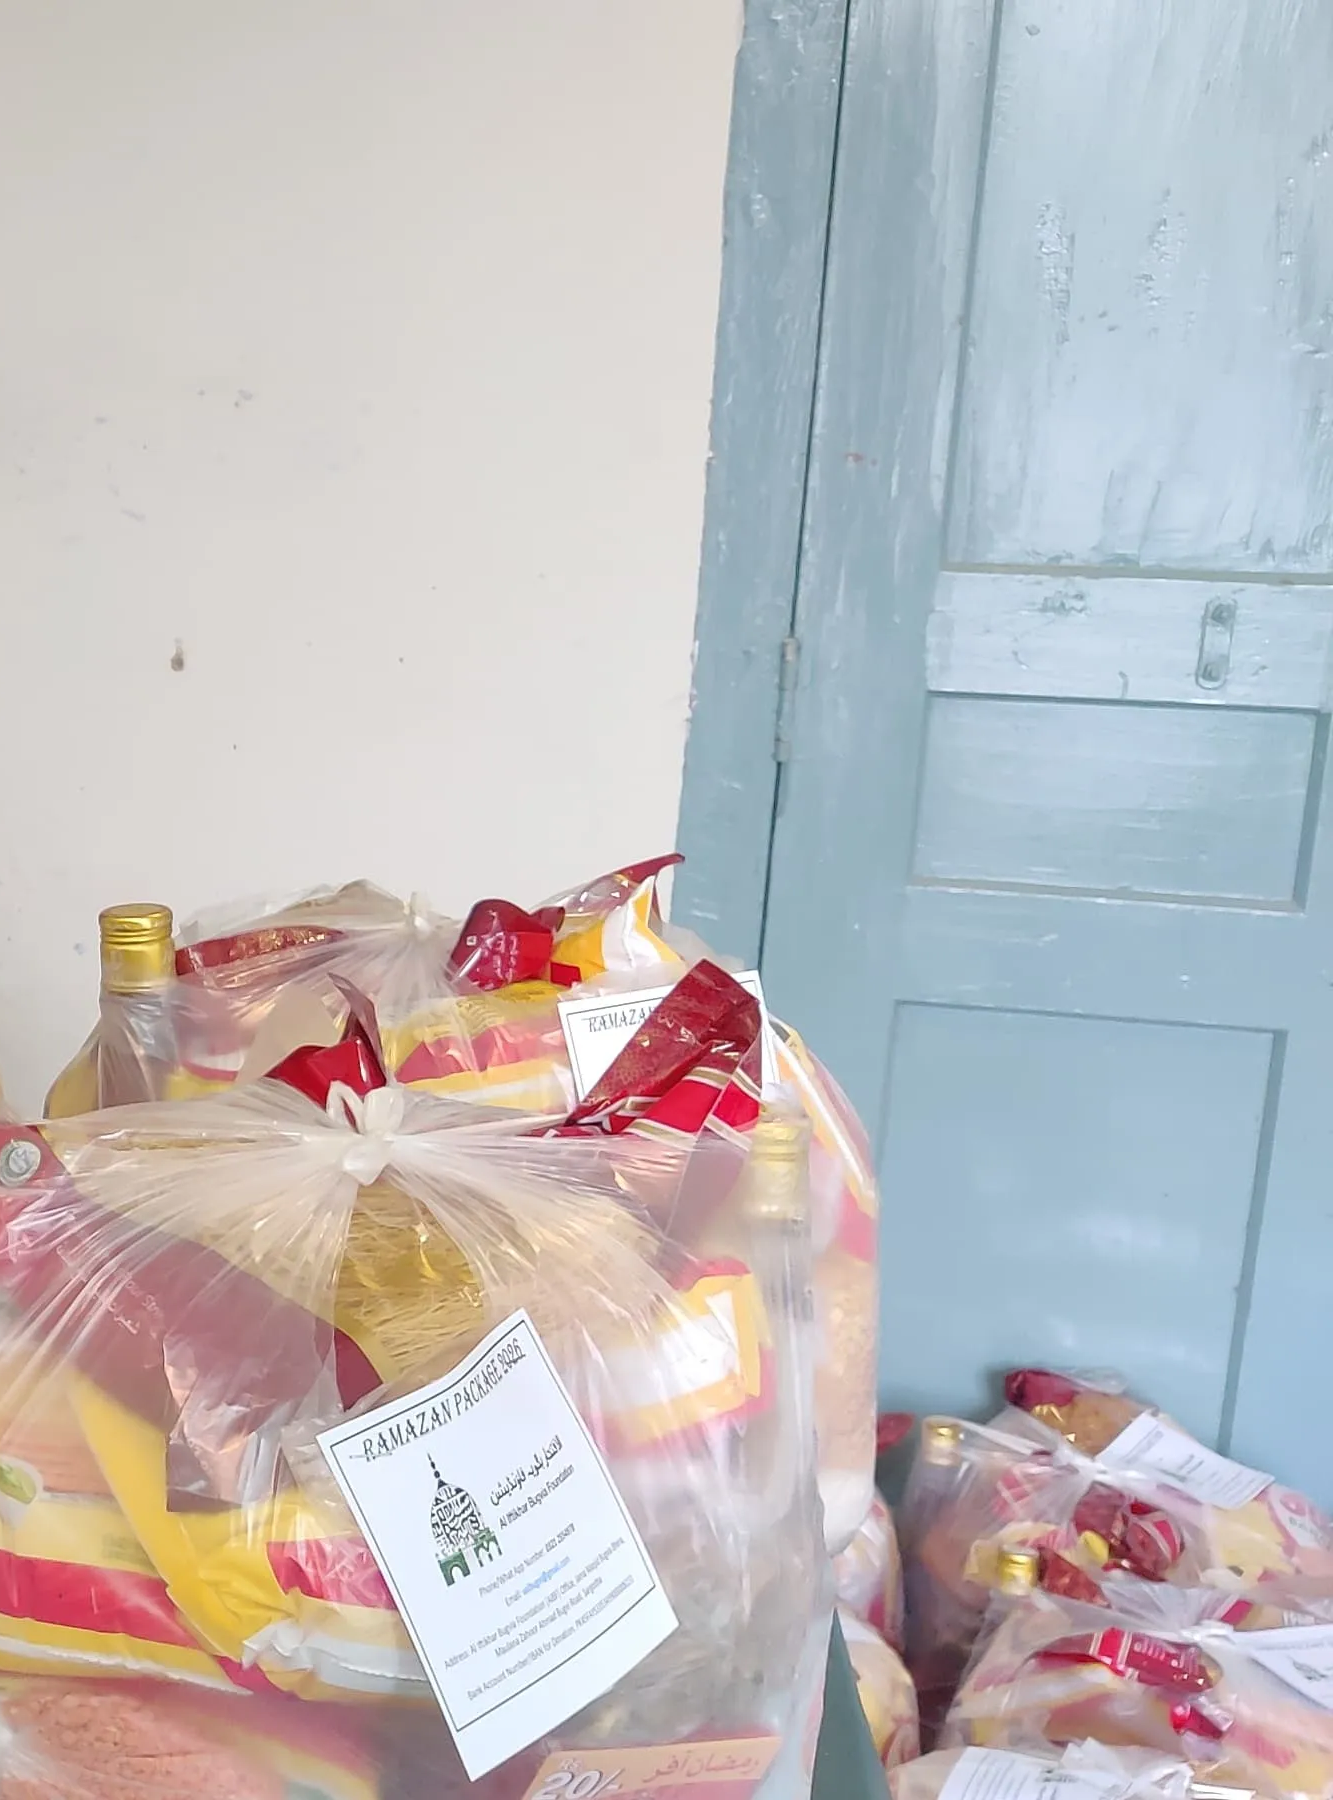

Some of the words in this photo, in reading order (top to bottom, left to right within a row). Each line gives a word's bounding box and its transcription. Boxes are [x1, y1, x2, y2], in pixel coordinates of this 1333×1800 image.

[363, 1398, 454, 1462] RAMAZAN
[453, 1358, 503, 1416] PACKAGE
[497, 1337, 525, 1374] 2026
